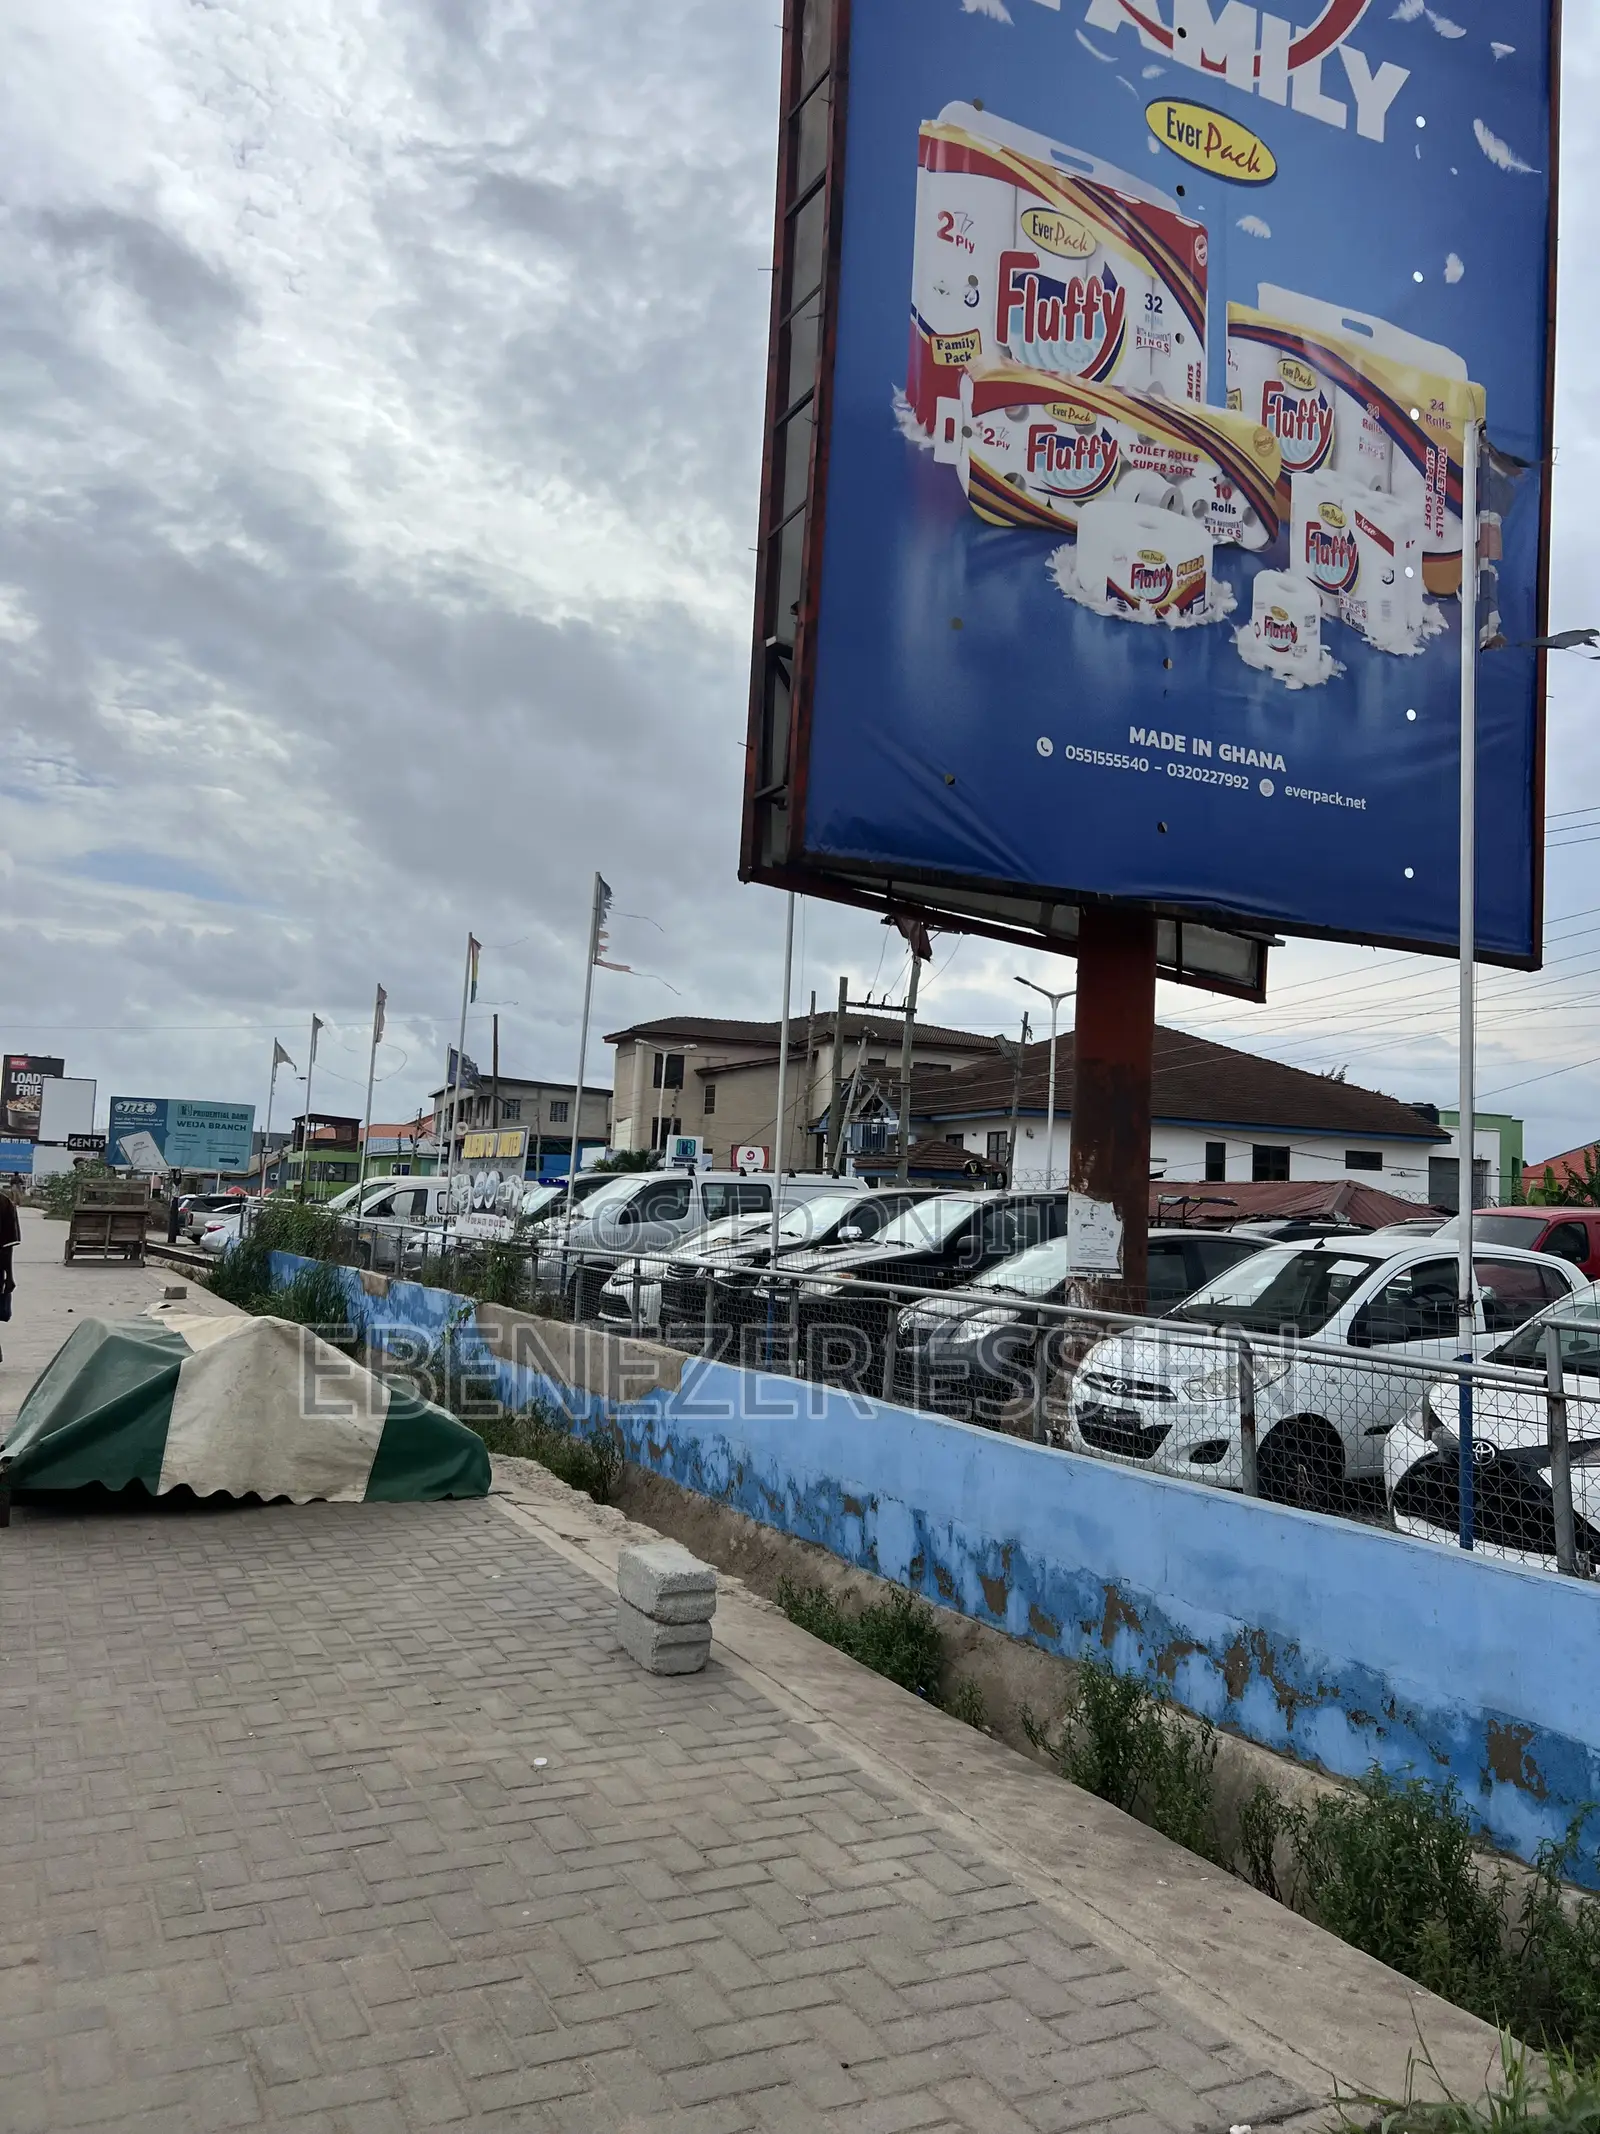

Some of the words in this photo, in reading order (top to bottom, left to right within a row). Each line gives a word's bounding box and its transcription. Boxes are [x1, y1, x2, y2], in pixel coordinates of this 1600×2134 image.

[1033, 0, 1410, 143] AMILY
[1167, 106, 1202, 150] Ever
[1203, 121, 1260, 173] Pack
[937, 210, 955, 243] 2
[956, 235, 975, 254] Ply
[1032, 214, 1054, 241] Ever
[1054, 221, 1087, 252] Pack
[996, 250, 1126, 362] Fluffy
[1144, 293, 1163, 314] 32
[936, 337, 976, 350] Family
[1136, 336, 1170, 353] RINGS
[944, 351, 972, 363] Pack
[1052, 404, 1068, 416] Ever
[1067, 407, 1091, 422] Pack
[1261, 380, 1333, 453] Fluffy
[1430, 399, 1445, 412] 24
[1425, 413, 1452, 430] Rolls
[983, 427, 996, 446] 2
[996, 440, 1010, 451] Ply
[1027, 423, 1119, 480] Fluffy
[1129, 444, 1166, 457] TOILET
[1167, 449, 1200, 463] ROLLS
[1132, 459, 1167, 473] SUPER
[1169, 465, 1195, 477] SOFT
[1426, 447, 1434, 492] SUPER
[1438, 447, 1447, 493] TOILET
[1214, 483, 1233, 500] 10
[1211, 501, 1237, 514] Rolls
[1425, 495, 1433, 530] SOFT
[1436, 495, 1444, 538] ROLLS
[1204, 525, 1241, 539] RINGS
[1357, 517, 1377, 536] New
[1304, 521, 1357, 574] Fluffy
[1176, 554, 1204, 577] MEGA
[1131, 563, 1174, 594] Fluffy
[1264, 614, 1298, 642] Fluffy
[1129, 725, 1186, 754] MADE
[1192, 738, 1212, 758] IN
[1218, 743, 1287, 773] GHANA
[1065, 744, 1149, 773] 0551555540
[1167, 762, 1250, 791] 0320227992
[1285, 783, 1367, 811] everpack.net
[11, 1072, 54, 1084] LOAD
[16, 1085, 41, 1096] FRIE
[177, 1120, 206, 1129] WEIJA
[208, 1122, 247, 1132] BRANCH
[192, 1110, 230, 1119] PRUDENTIAL
[69, 1138, 105, 1149] GENTS
